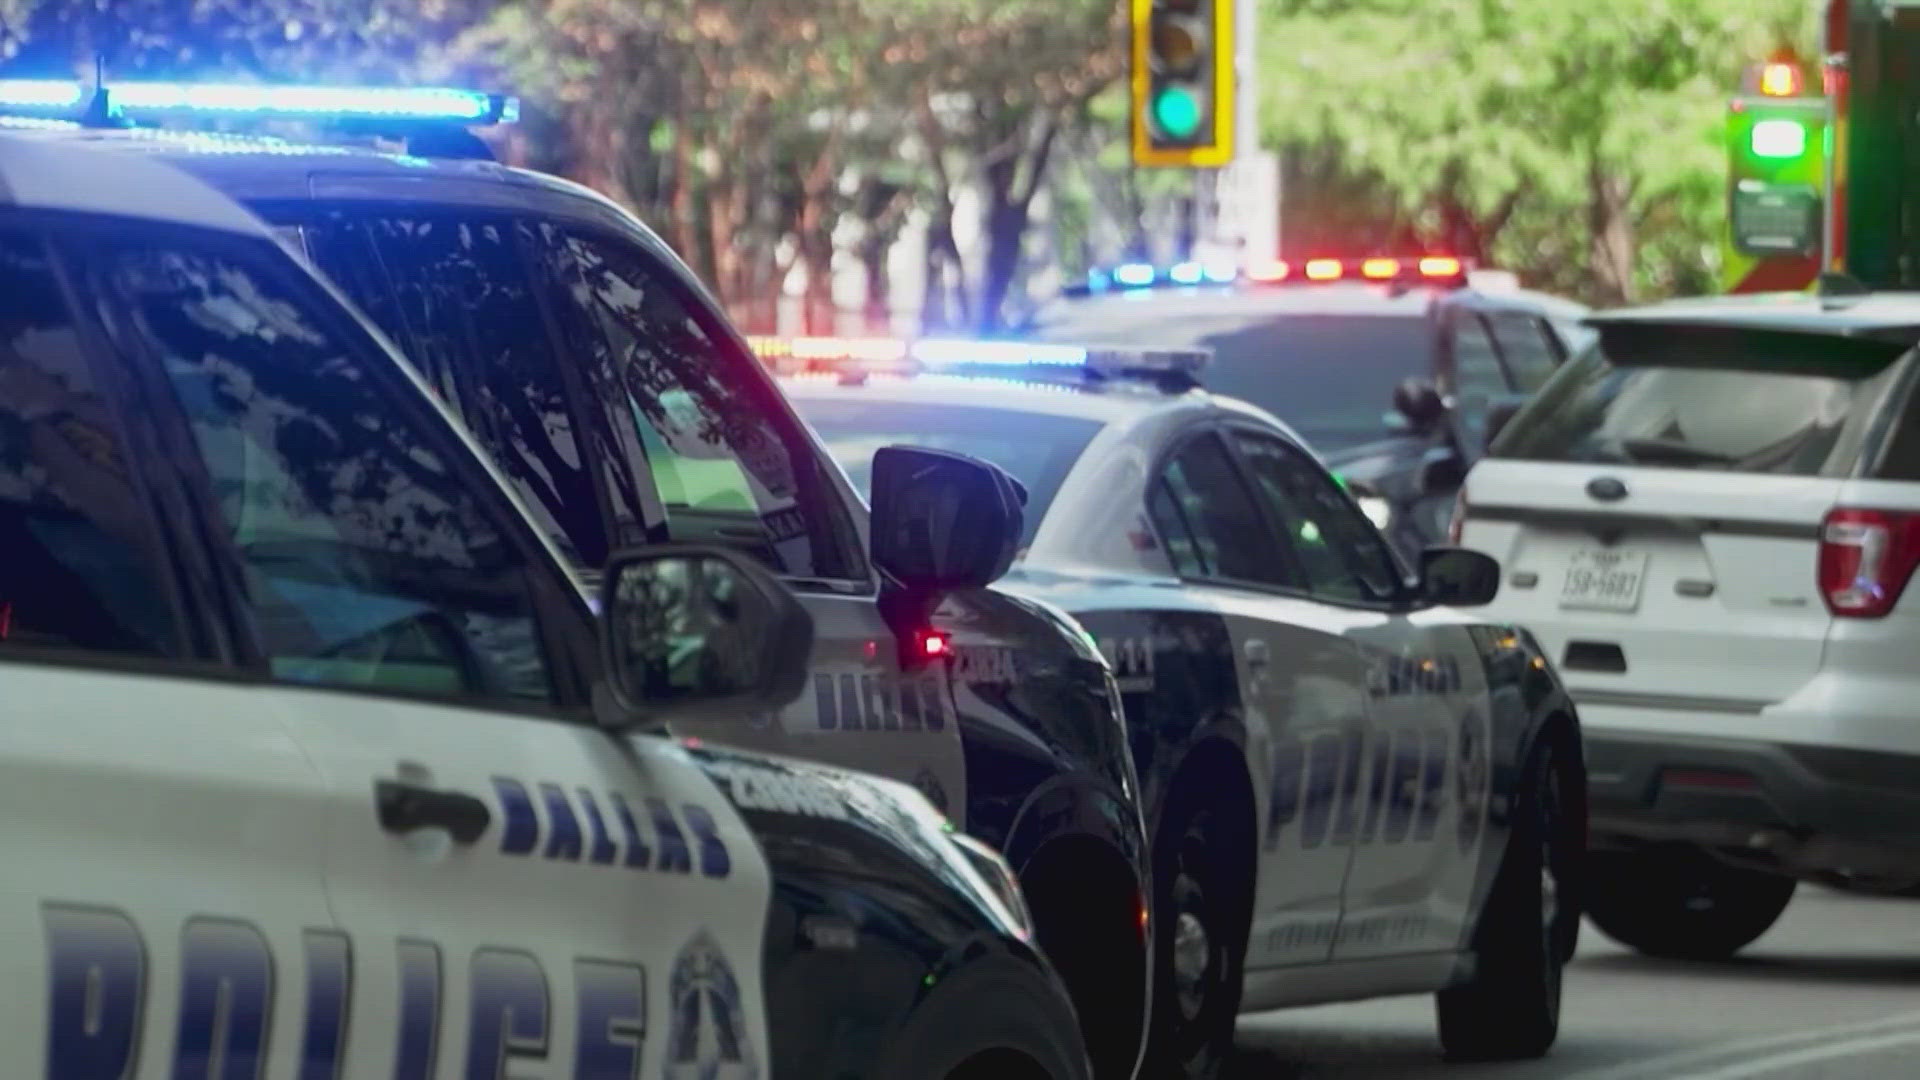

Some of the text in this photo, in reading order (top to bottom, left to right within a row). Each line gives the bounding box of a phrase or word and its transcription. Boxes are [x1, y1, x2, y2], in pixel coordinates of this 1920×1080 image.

[490, 774, 732, 880] DALLAS
[1262, 732, 1451, 852] POLICE
[40, 899, 648, 1080] POLICE
